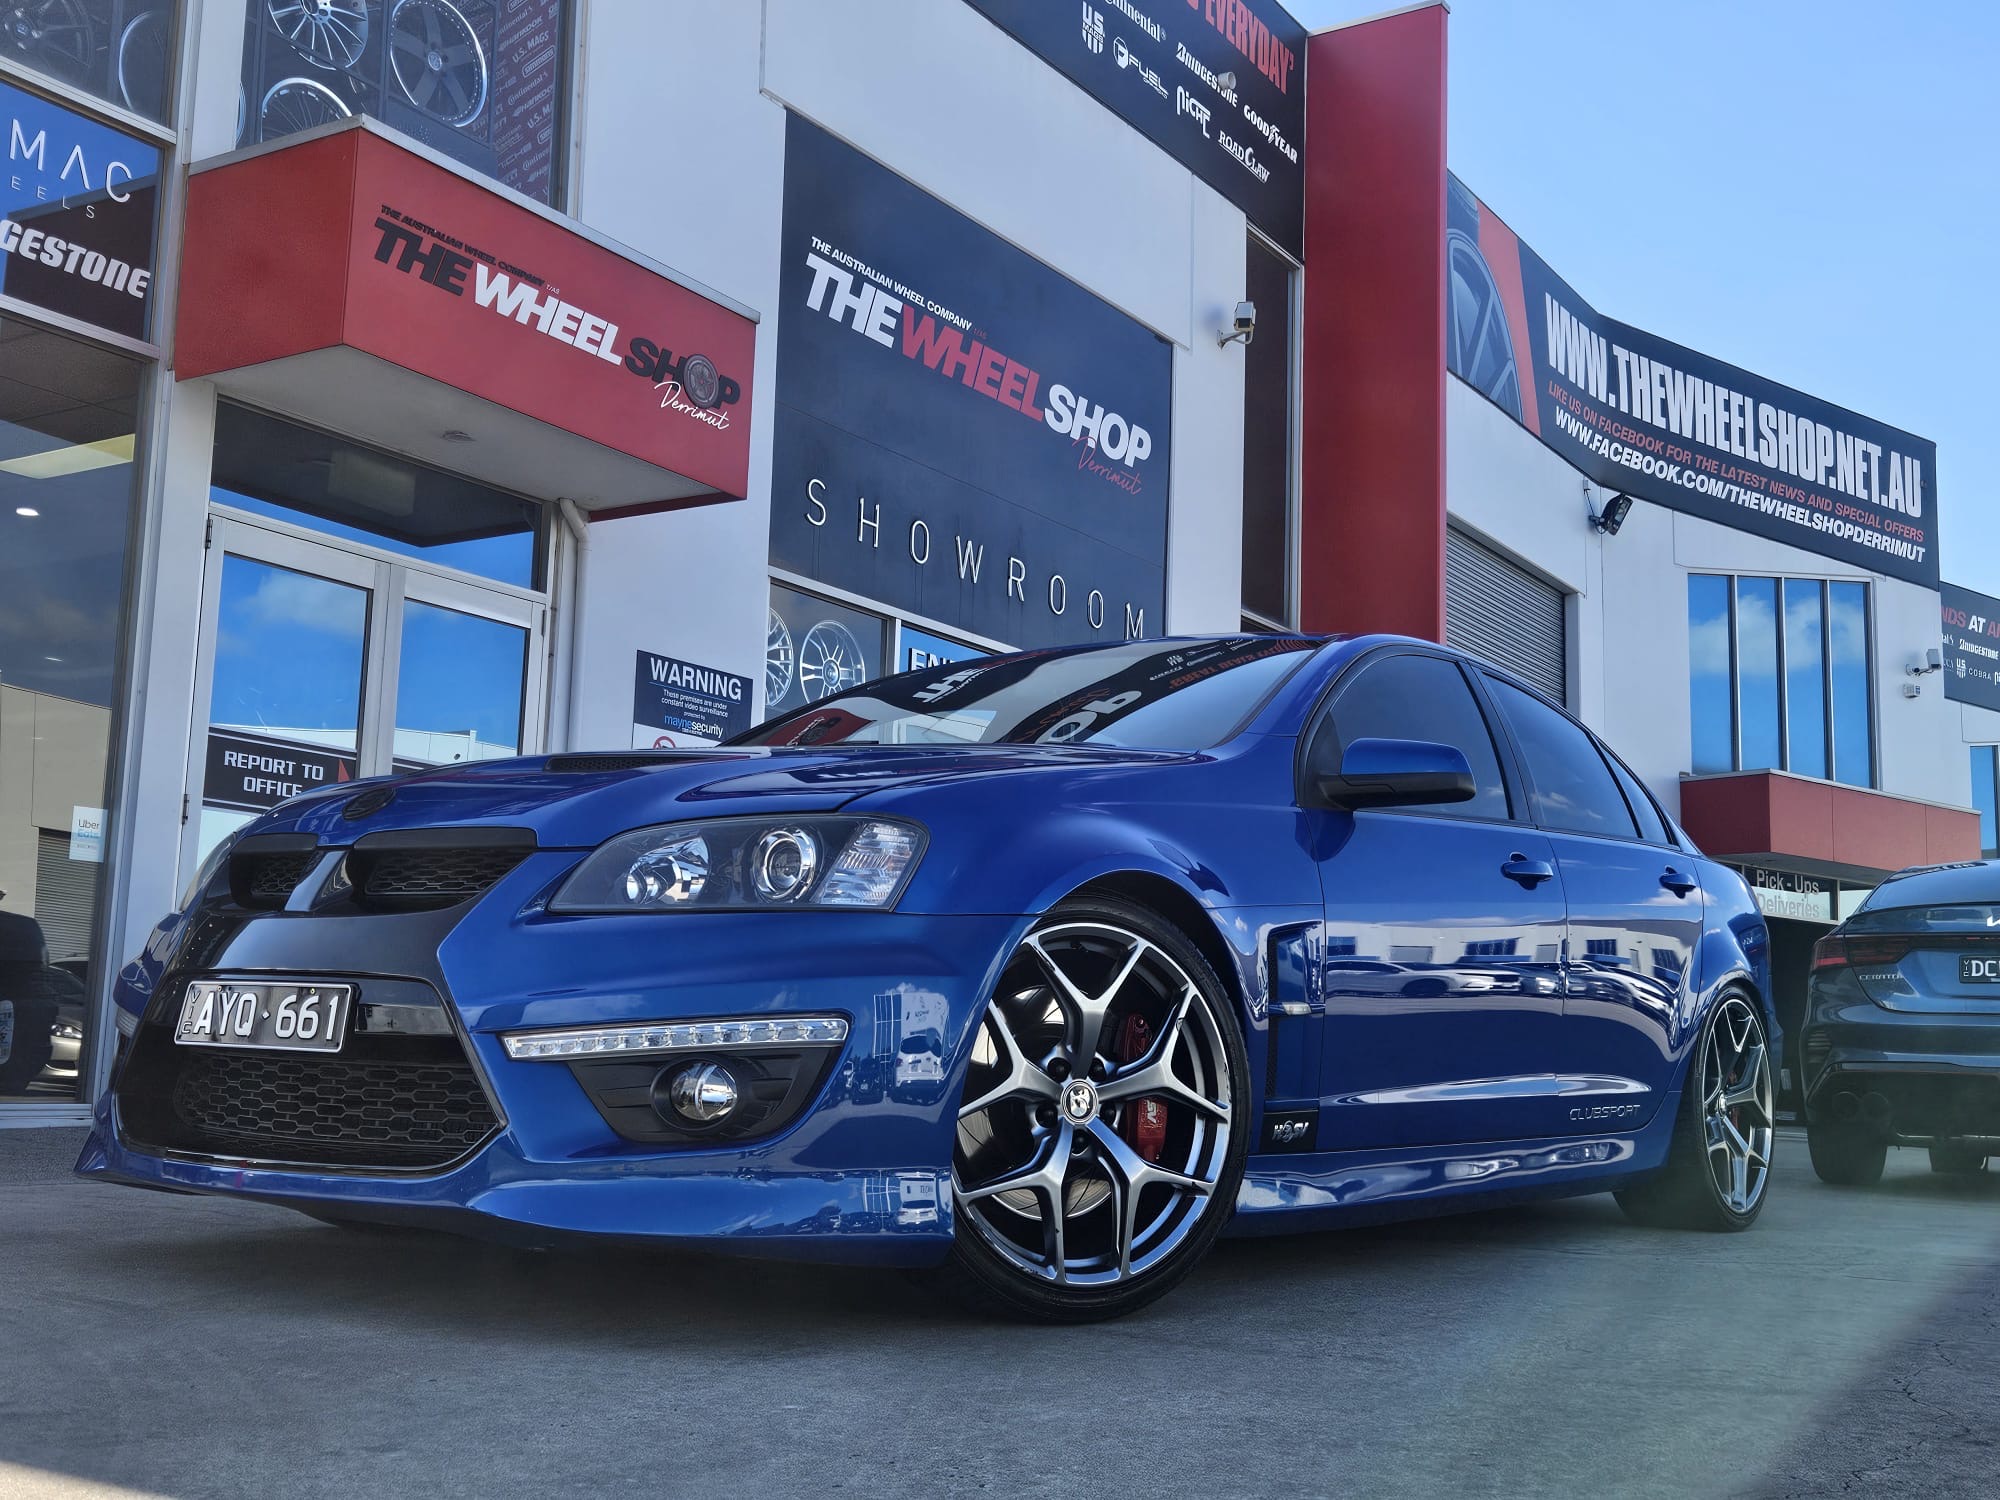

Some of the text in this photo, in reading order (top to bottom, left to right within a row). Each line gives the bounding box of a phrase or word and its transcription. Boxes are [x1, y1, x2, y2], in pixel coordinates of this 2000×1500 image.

[381, 204, 402, 221] THE
[401, 215, 463, 250] AUSTRALIAN
[464, 243, 496, 266] WHEEL
[498, 260, 545, 287] COMPANY
[811, 236, 831, 256] THE
[832, 249, 893, 289] AUSTRALIAN
[894, 281, 926, 308] WHEEL
[927, 300, 972, 331] COMPANY
[654, 380, 730, 430] Derrimut
[1545, 291, 1922, 519] WWW.THEWHEELSHOP.NET.AU
[1072, 436, 1142, 495] Derrimut
[1548, 380, 1924, 543] LIKE US ON FACEBOOK FOR THE LATEST NEWS AND SPECIAL OFFERS
[1555, 405, 1926, 563] WWW.FACEBOOK.COM/THEWHEELSHOPDERRIMUT
[805, 478, 1144, 640] SHOWROOM
[1968, 615, 1986, 634] AT
[1959, 638, 1999, 660] BRIDGESTONE
[650, 657, 742, 701] WARNING
[1968, 667, 1992, 681] COBRA
[661, 697, 728, 718] constant video surveillance
[663, 688, 728, 710] These premises are under
[664, 715, 723, 738] maynesecurity
[224, 750, 324, 781] REPORT TO
[78, 819, 100, 830] Uber
[1756, 869, 1785, 891] Pick
[1795, 875, 1819, 899] Ups
[1756, 893, 1820, 918] Deliveries
[181, 990, 200, 1034] VIC
[1569, 1104, 1641, 1120] CLUBSPORT
